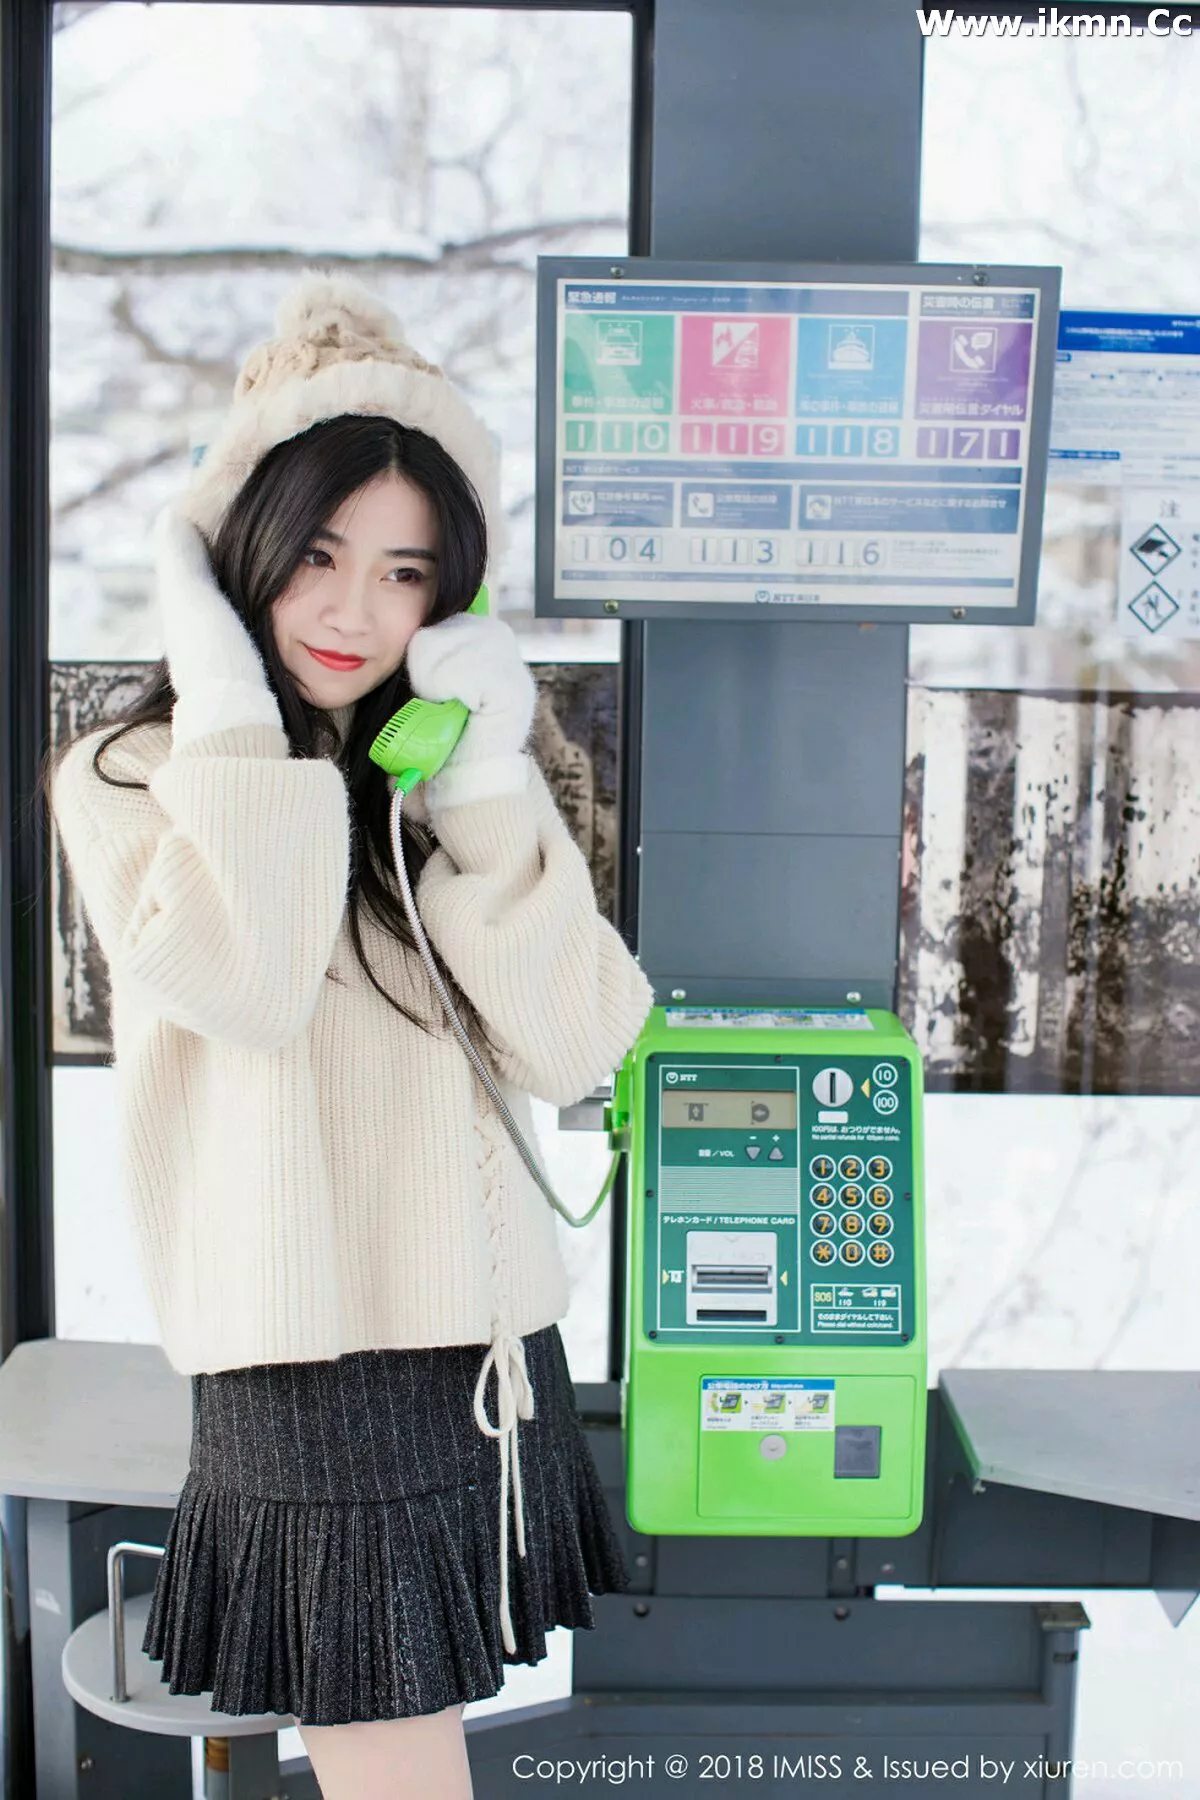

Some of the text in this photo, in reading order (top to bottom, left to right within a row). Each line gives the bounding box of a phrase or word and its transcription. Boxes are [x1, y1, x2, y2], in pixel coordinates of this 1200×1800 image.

[878, 1069, 892, 1081] 10
[877, 1097, 895, 1108] 100
[820, 1159, 886, 1176] 1 2 3
[816, 1187, 886, 1204] 4 5 6
[662, 1216, 712, 1224] テレホンカード
[719, 1217, 768, 1225] TELEPHONE
[770, 1217, 796, 1225] CARD
[816, 1215, 886, 1233] 7 8 9
[814, 1291, 833, 1302] SOS
